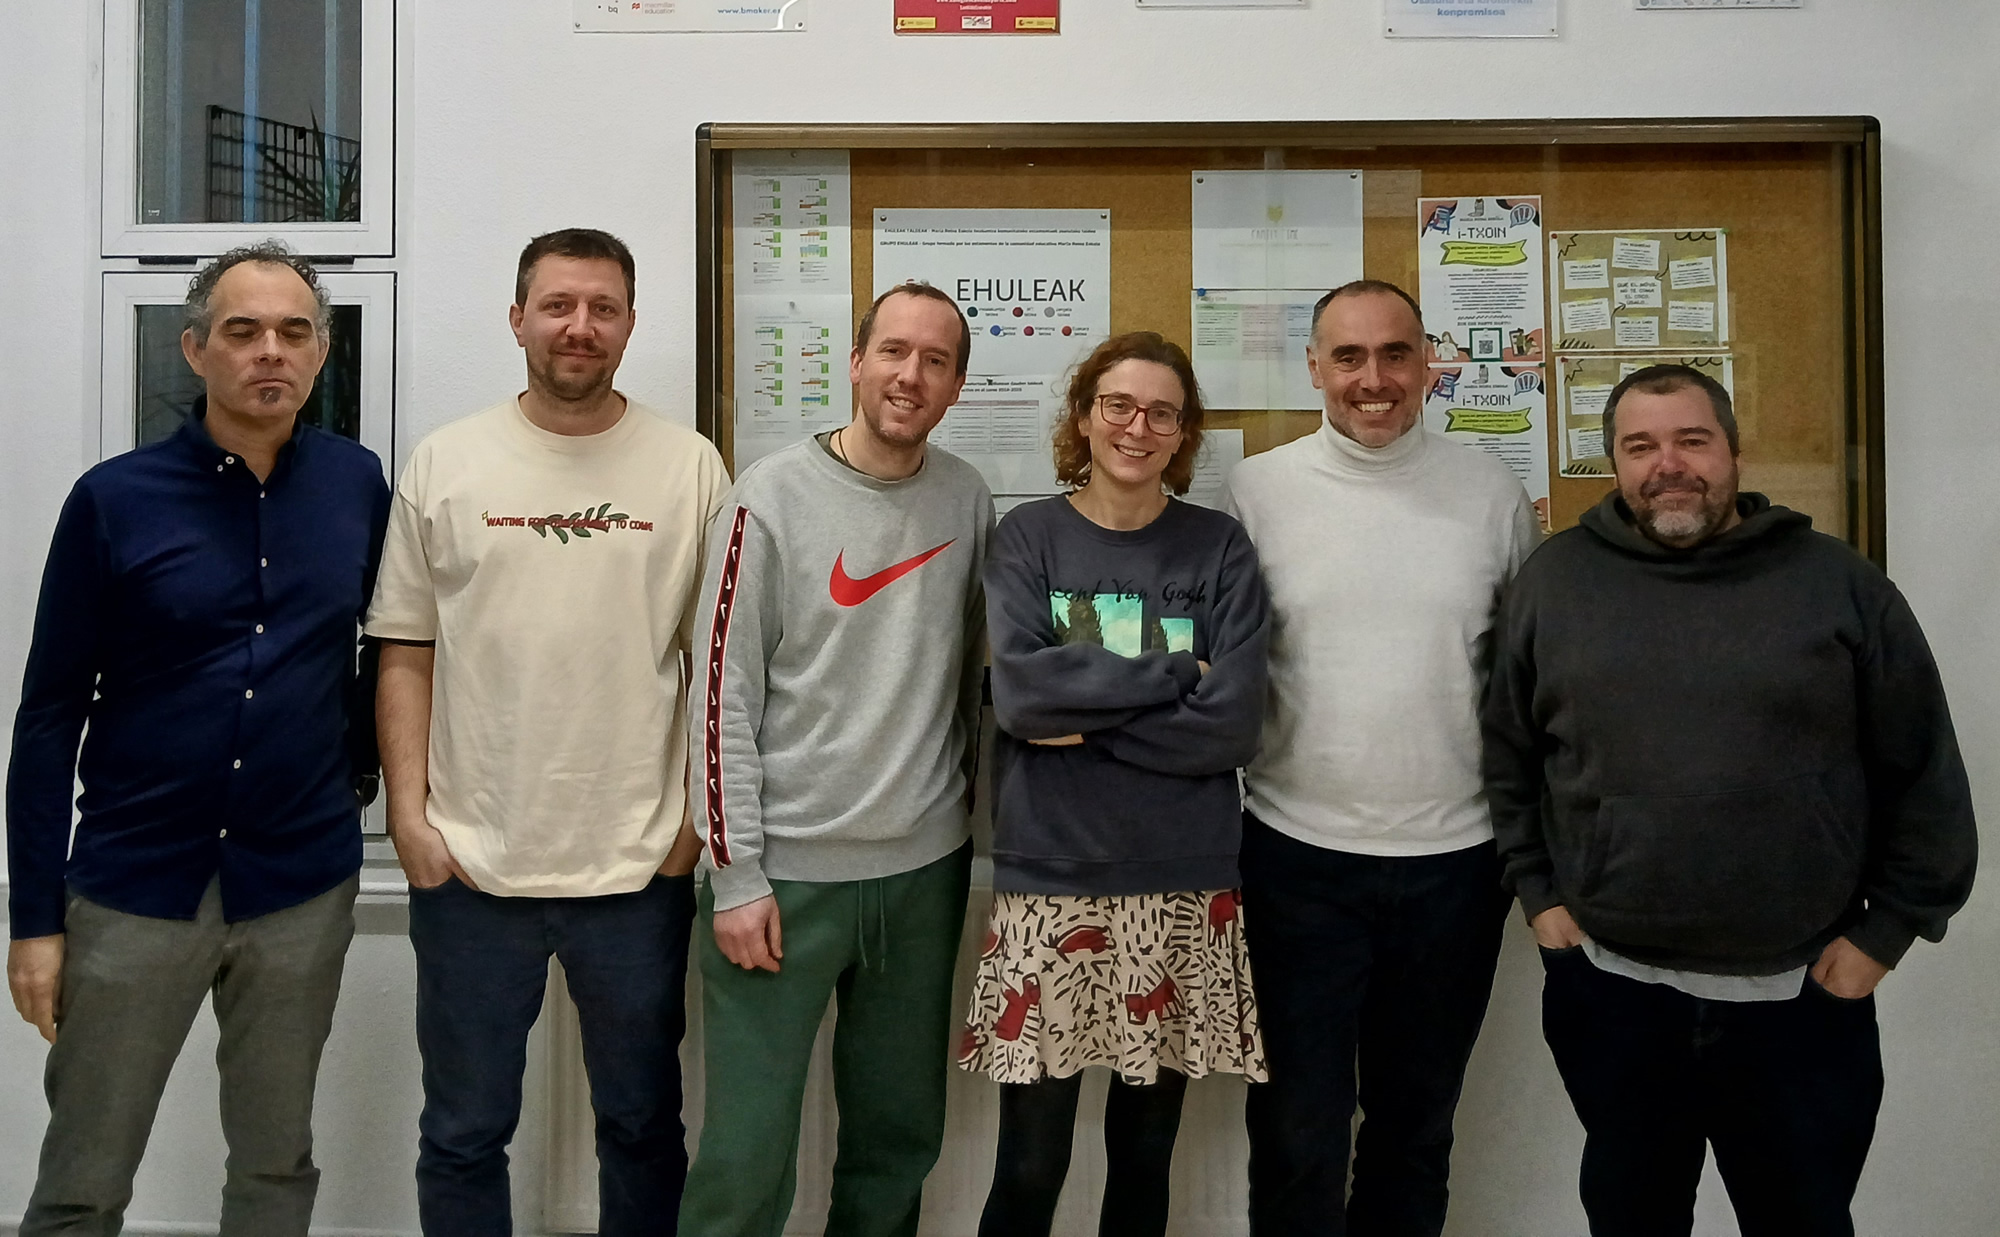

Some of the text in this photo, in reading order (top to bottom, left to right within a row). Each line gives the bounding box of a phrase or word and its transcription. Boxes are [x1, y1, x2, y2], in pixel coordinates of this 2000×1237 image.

[1437, 8, 1506, 17] konpromisoa
[1458, 226, 1507, 239] i-TXOIN
[957, 278, 1086, 301] EHULEAK
[1462, 394, 1511, 406] i-TXOIN
[487, 517, 525, 527] WAITING
[615, 518, 627, 530] TO
[629, 520, 653, 532] COME
[1111, 578, 1149, 603] Van
[1162, 579, 1208, 612] Gogh
